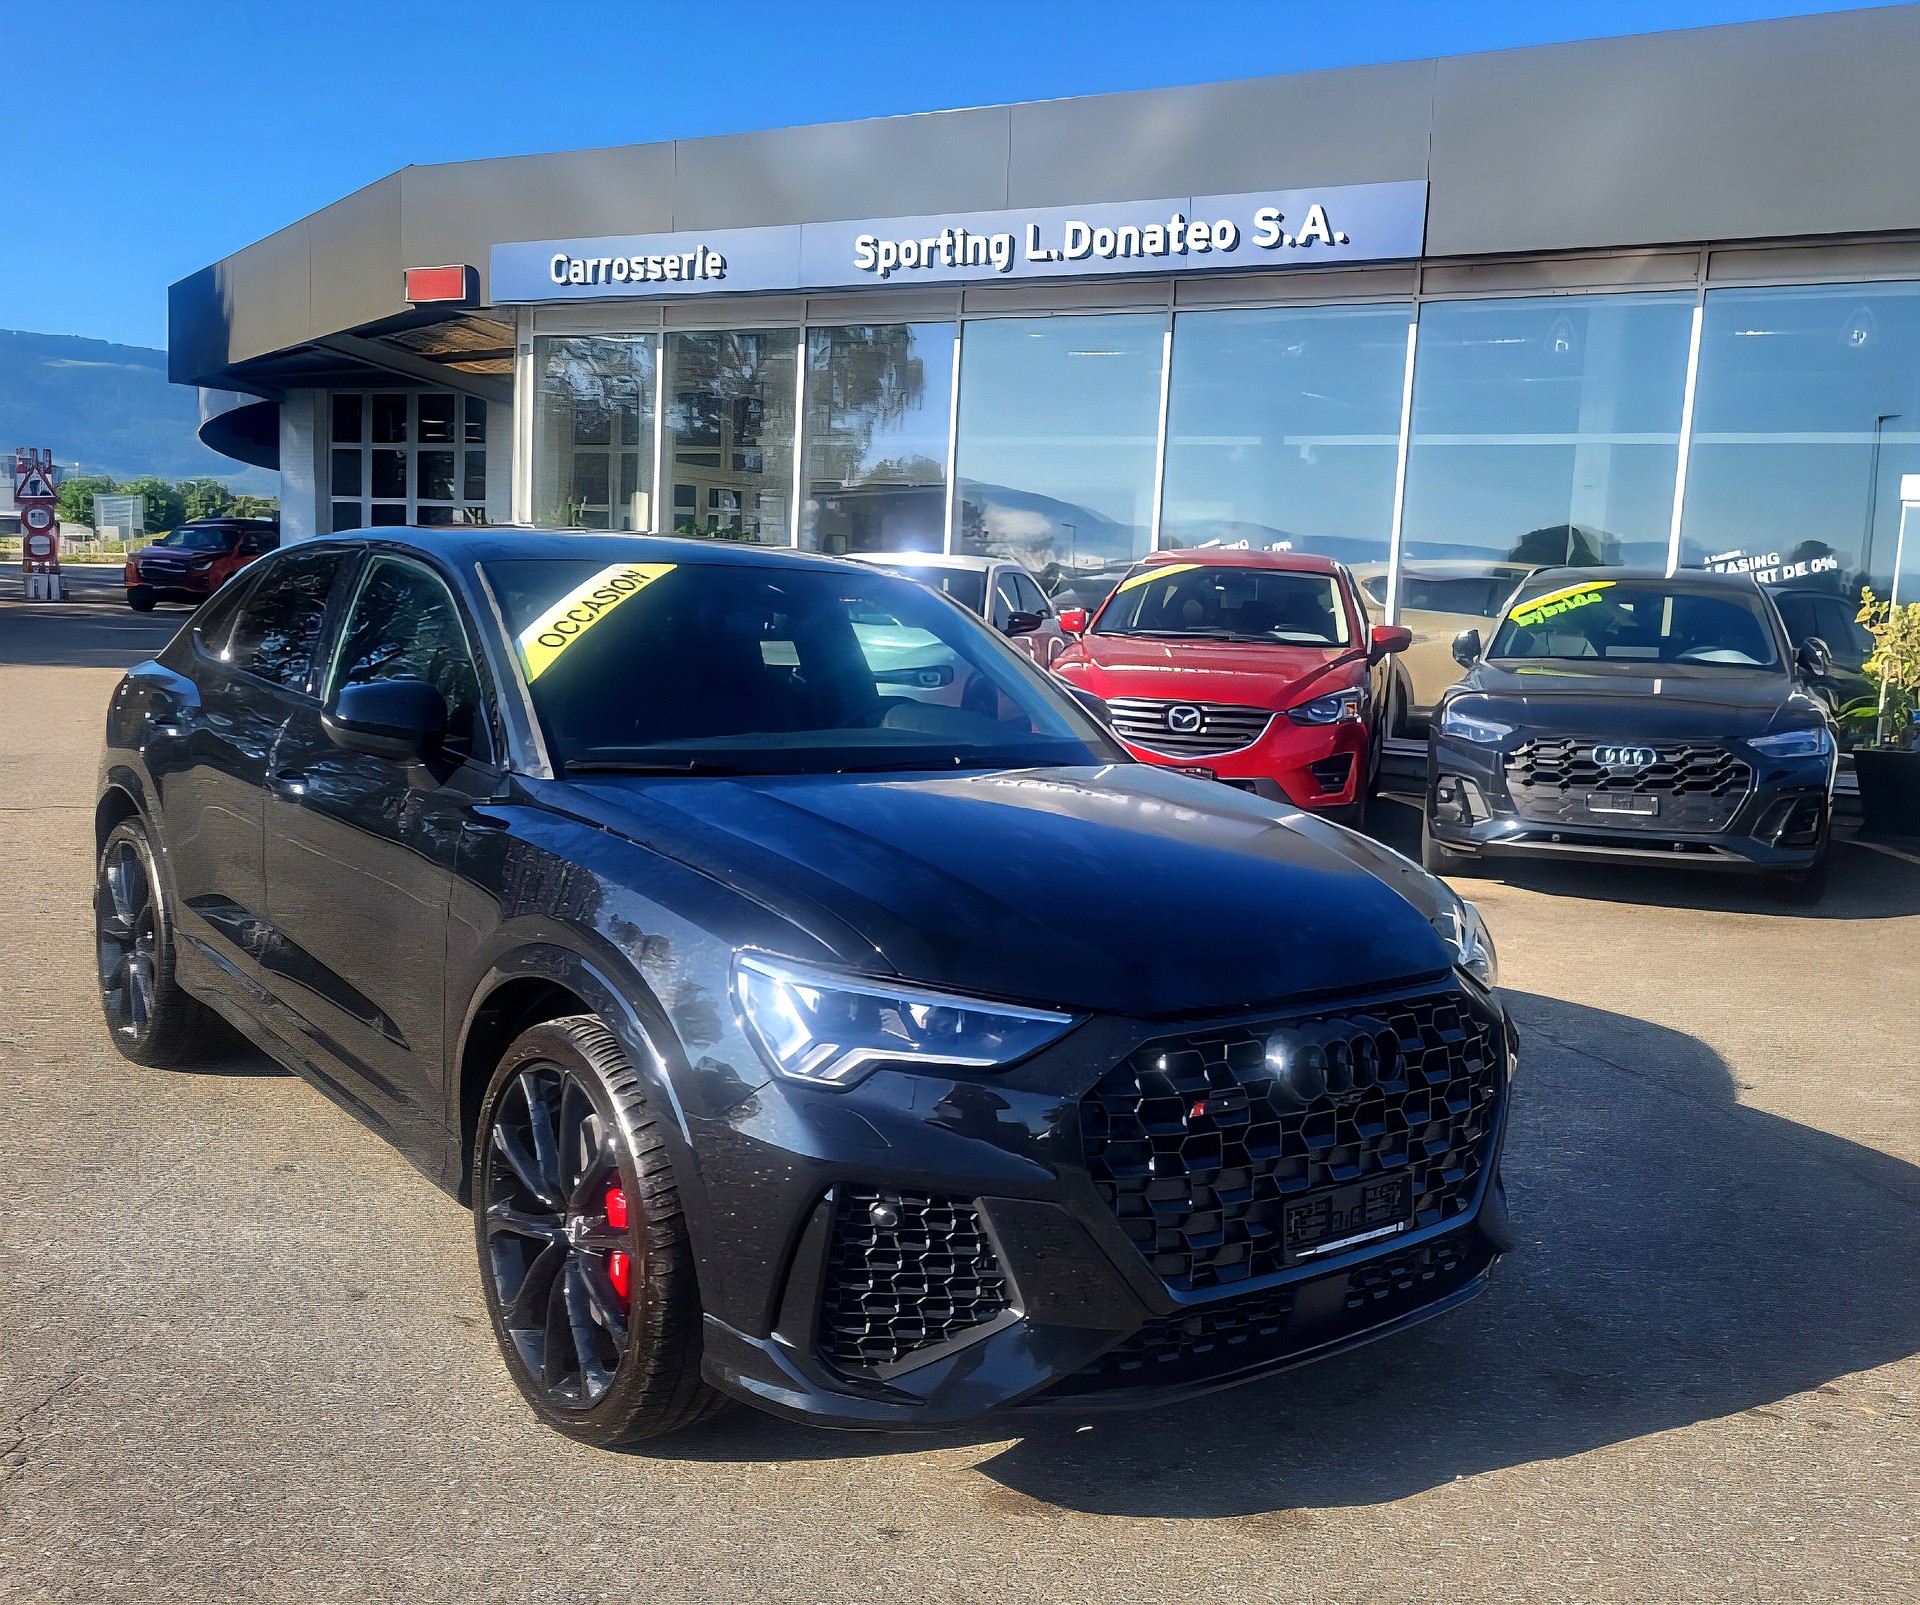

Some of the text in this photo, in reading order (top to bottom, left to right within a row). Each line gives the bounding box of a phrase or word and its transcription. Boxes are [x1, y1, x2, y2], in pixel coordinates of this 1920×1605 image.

[550, 244, 724, 285] Carrosserie
[853, 228, 1011, 277] Sporting
[1252, 203, 1347, 248] S.A.
[537, 569, 651, 648] OCCASION
